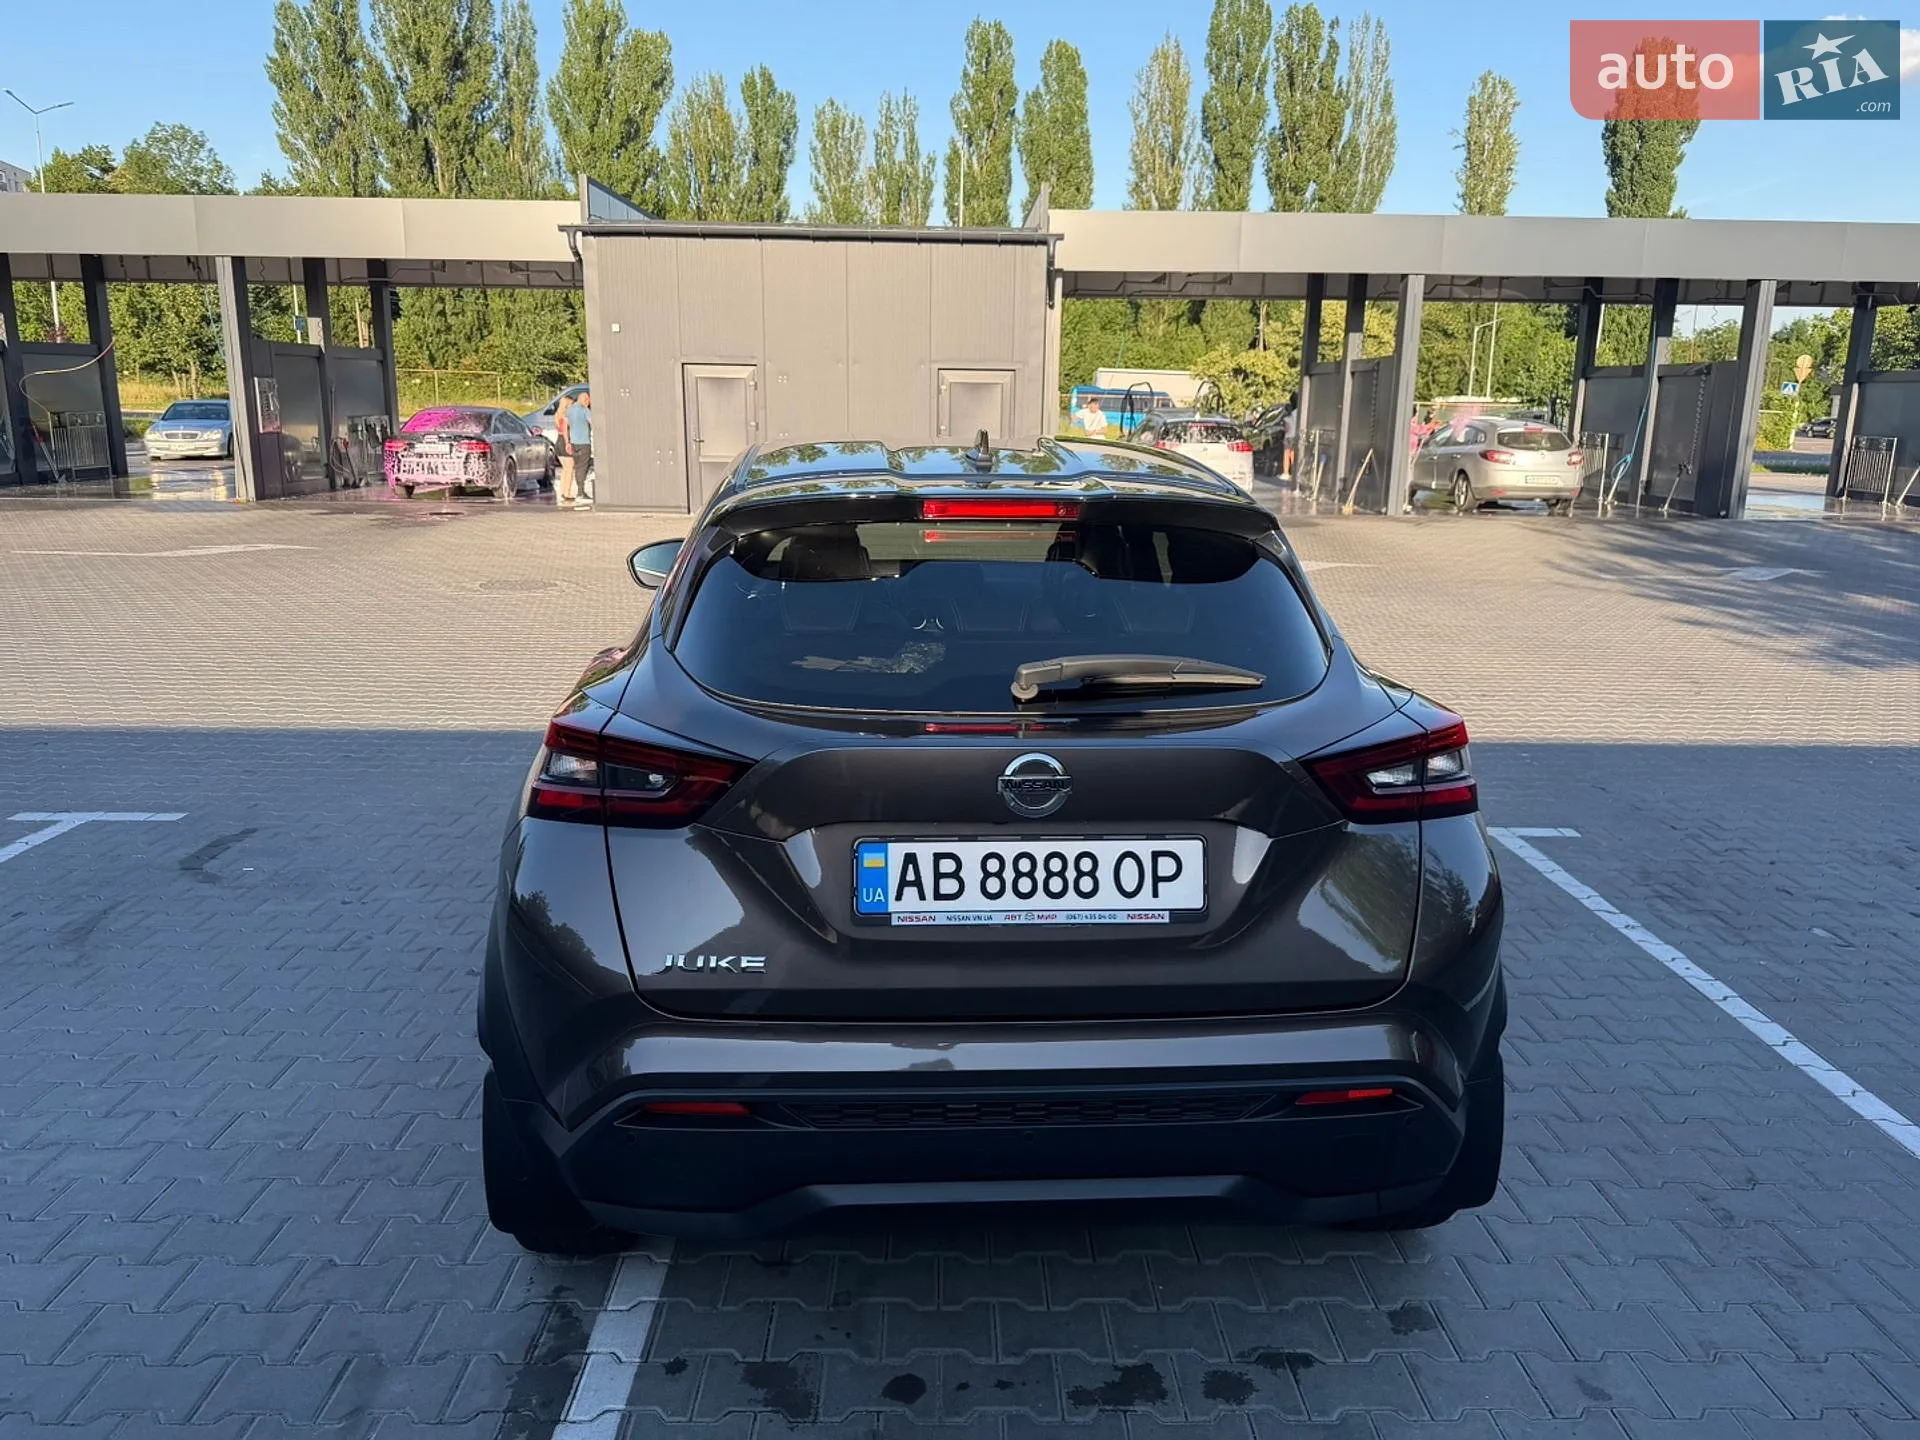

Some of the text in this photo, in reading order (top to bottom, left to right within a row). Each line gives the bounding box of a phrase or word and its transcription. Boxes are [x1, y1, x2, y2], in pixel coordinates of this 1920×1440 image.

[1005, 781, 1065, 791] NISSAN
[894, 850, 1183, 901] AB 8888 OP
[862, 888, 886, 903] UA
[1126, 913, 1165, 921] NISSAN
[653, 953, 768, 975] JUKE
